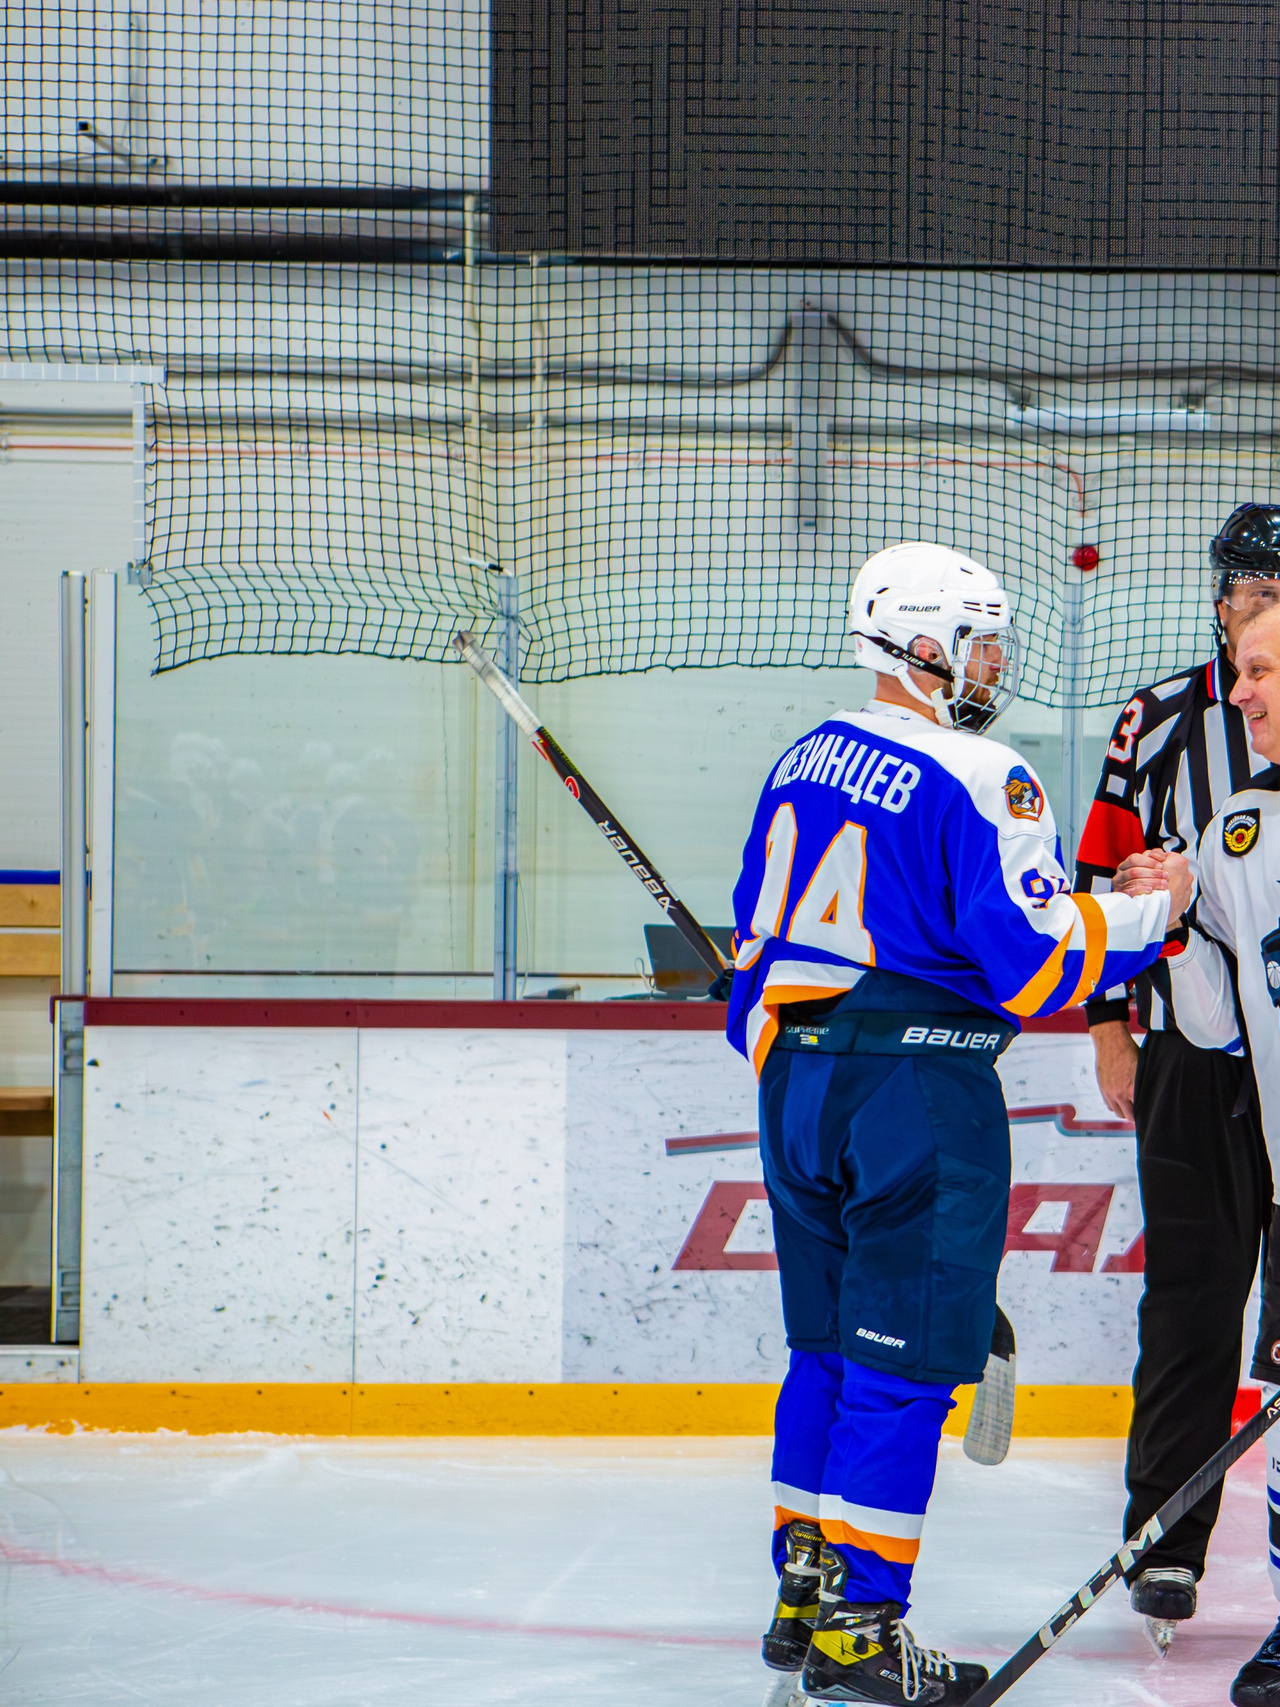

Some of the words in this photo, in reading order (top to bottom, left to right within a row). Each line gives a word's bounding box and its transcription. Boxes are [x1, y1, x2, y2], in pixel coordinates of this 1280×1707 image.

[899, 605, 941, 613] BAUER
[1107, 697, 1145, 764] 3
[597, 820, 664, 894] BAUER
[1020, 868, 1071, 910] 9
[901, 1026, 1000, 1050] BAUER
[856, 1327, 906, 1349] BAUER
[1038, 1514, 1164, 1648] CCM
